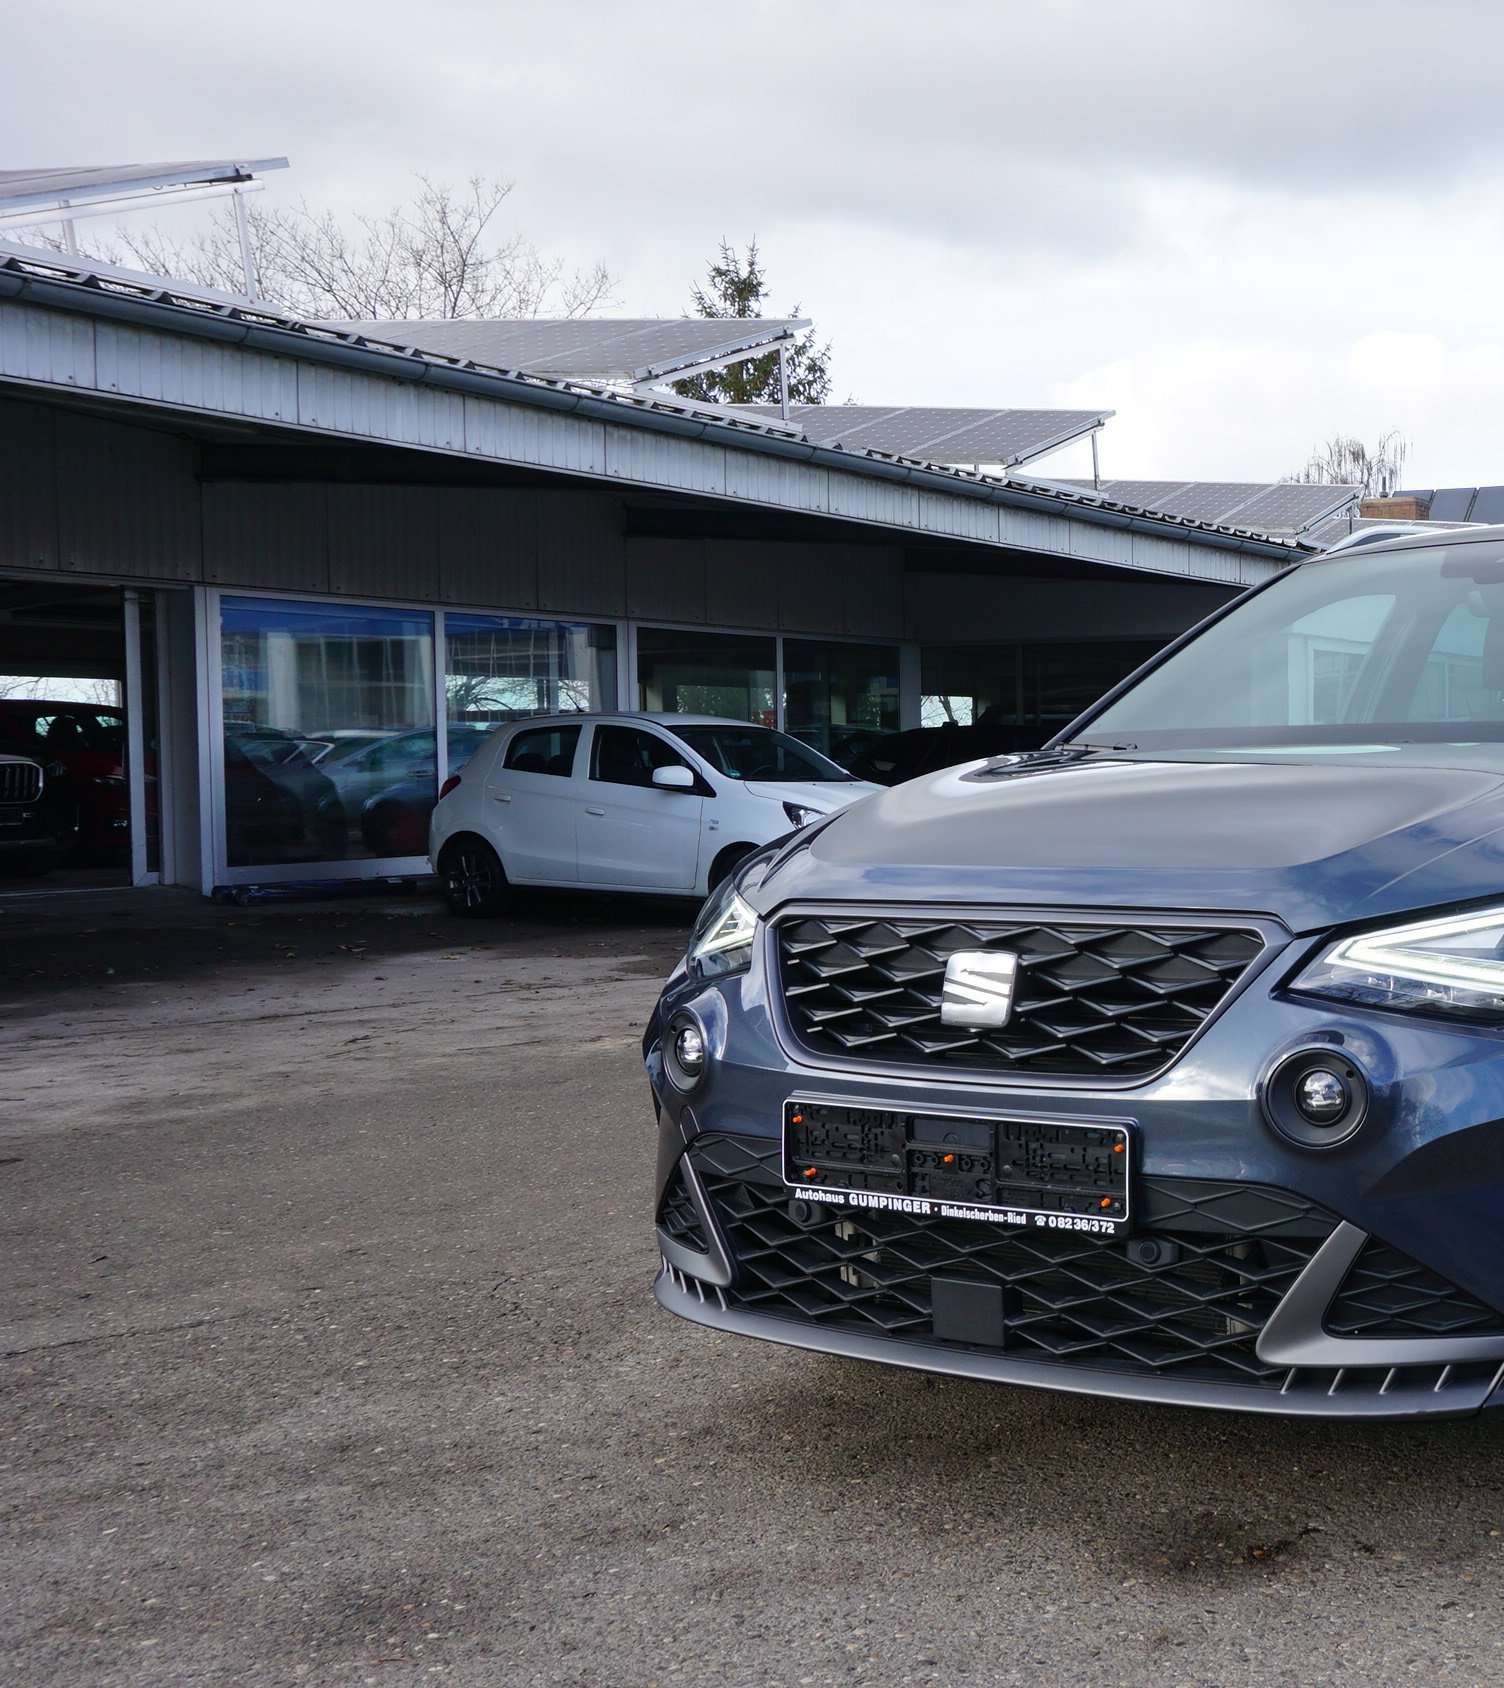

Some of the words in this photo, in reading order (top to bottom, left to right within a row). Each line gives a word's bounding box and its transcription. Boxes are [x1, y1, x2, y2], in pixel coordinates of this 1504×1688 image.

[795, 1188, 845, 1204] Autohaus
[849, 1193, 931, 1214] GUMPINGER
[941, 1205, 1026, 1225] Dinkelscherben-Ried
